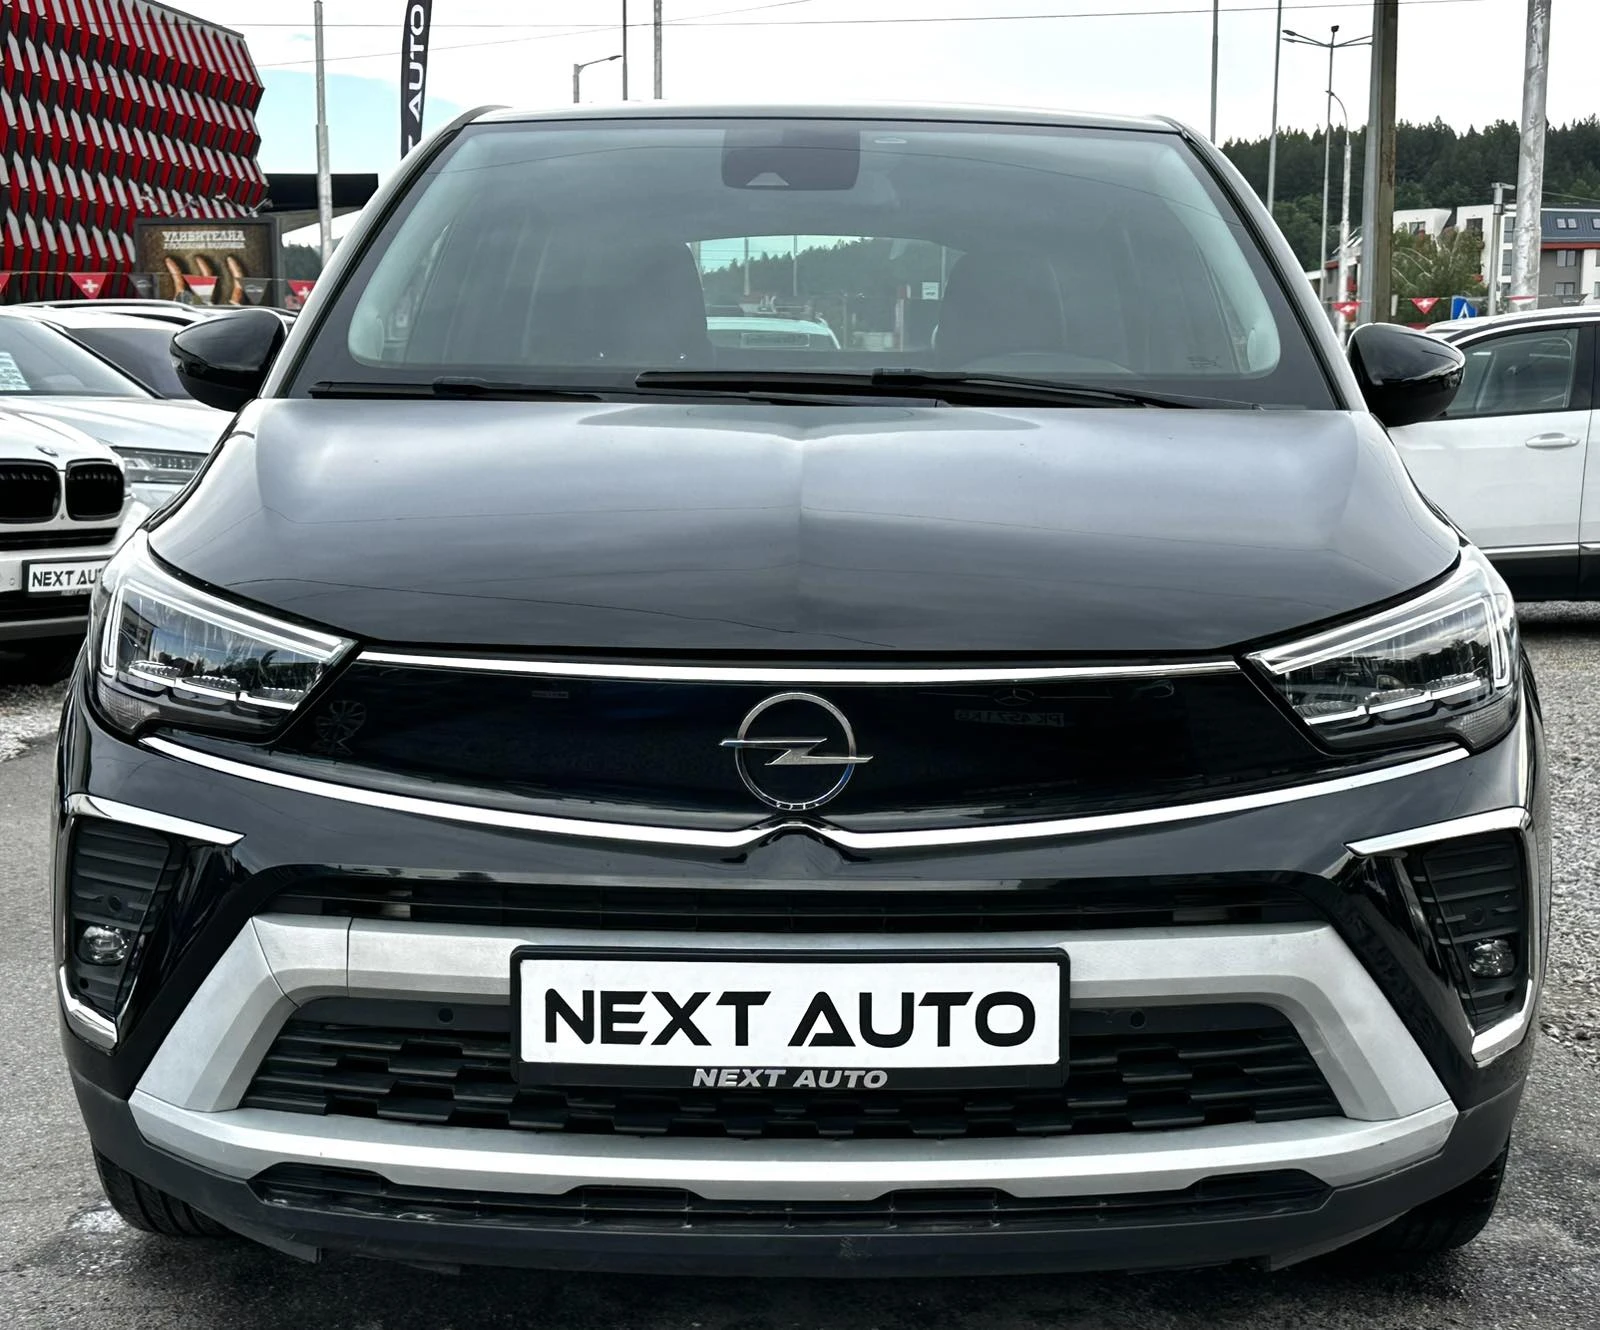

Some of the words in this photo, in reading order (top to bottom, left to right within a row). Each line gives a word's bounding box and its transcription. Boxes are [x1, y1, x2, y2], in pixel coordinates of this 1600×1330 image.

[408, 4, 425, 122] AUTO
[32, 570, 75, 587] NEXT
[76, 568, 102, 585] AU
[545, 989, 771, 1046] NEXT
[788, 991, 1036, 1048] AUTO
[692, 1068, 786, 1087] NEXT
[793, 1070, 888, 1088] AUTO
